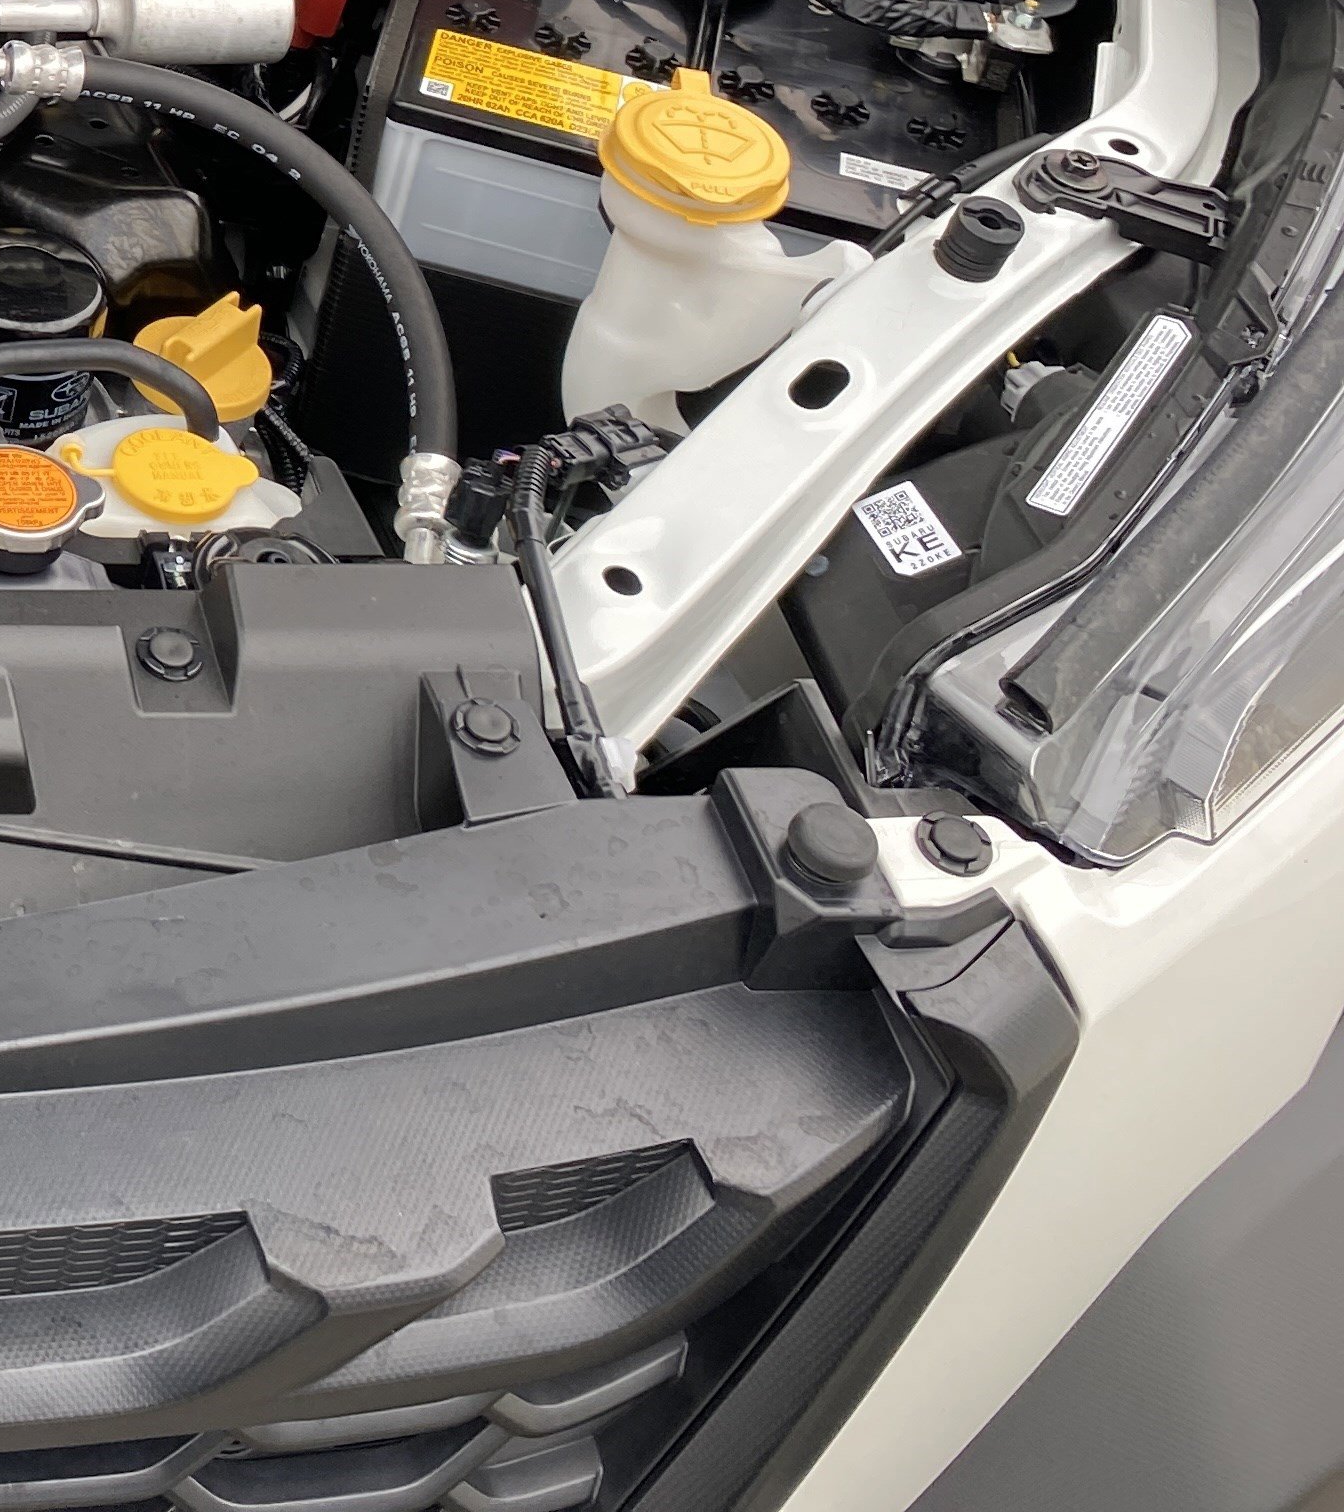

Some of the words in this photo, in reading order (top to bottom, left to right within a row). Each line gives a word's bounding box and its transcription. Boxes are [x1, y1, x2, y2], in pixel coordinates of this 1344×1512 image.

[440, 32, 492, 51] DANGER
[434, 55, 485, 74] POISON
[515, 108, 539, 120] CCA
[691, 181, 735, 197] PULL
[357, 238, 393, 303] YOKOHAMA
[19, 421, 49, 429] MADE
[886, 524, 936, 548] SUBARU
[889, 531, 945, 563] KE
